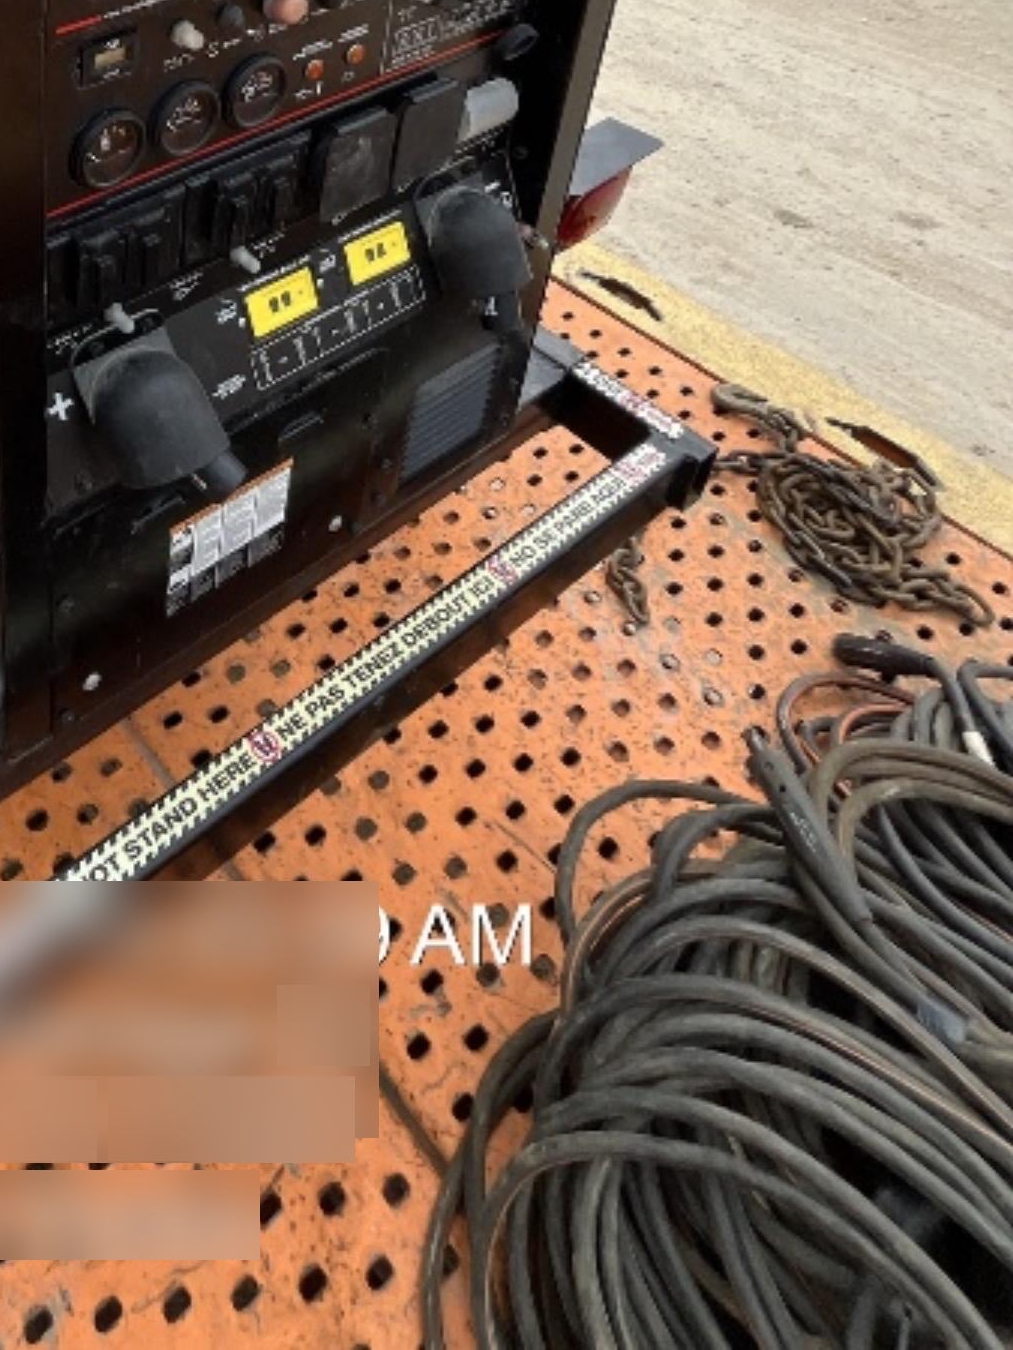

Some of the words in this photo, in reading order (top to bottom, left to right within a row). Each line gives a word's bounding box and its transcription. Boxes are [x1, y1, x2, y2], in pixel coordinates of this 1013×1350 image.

[123, 793, 198, 860] STAND
[198, 752, 257, 803] HERE
[277, 712, 306, 742] NE
[307, 685, 346, 720] PAS
[347, 639, 405, 692] TENEZ
[402, 593, 473, 647] DEBOUT
[471, 576, 496, 601] ICI
[509, 544, 537, 568] NO
